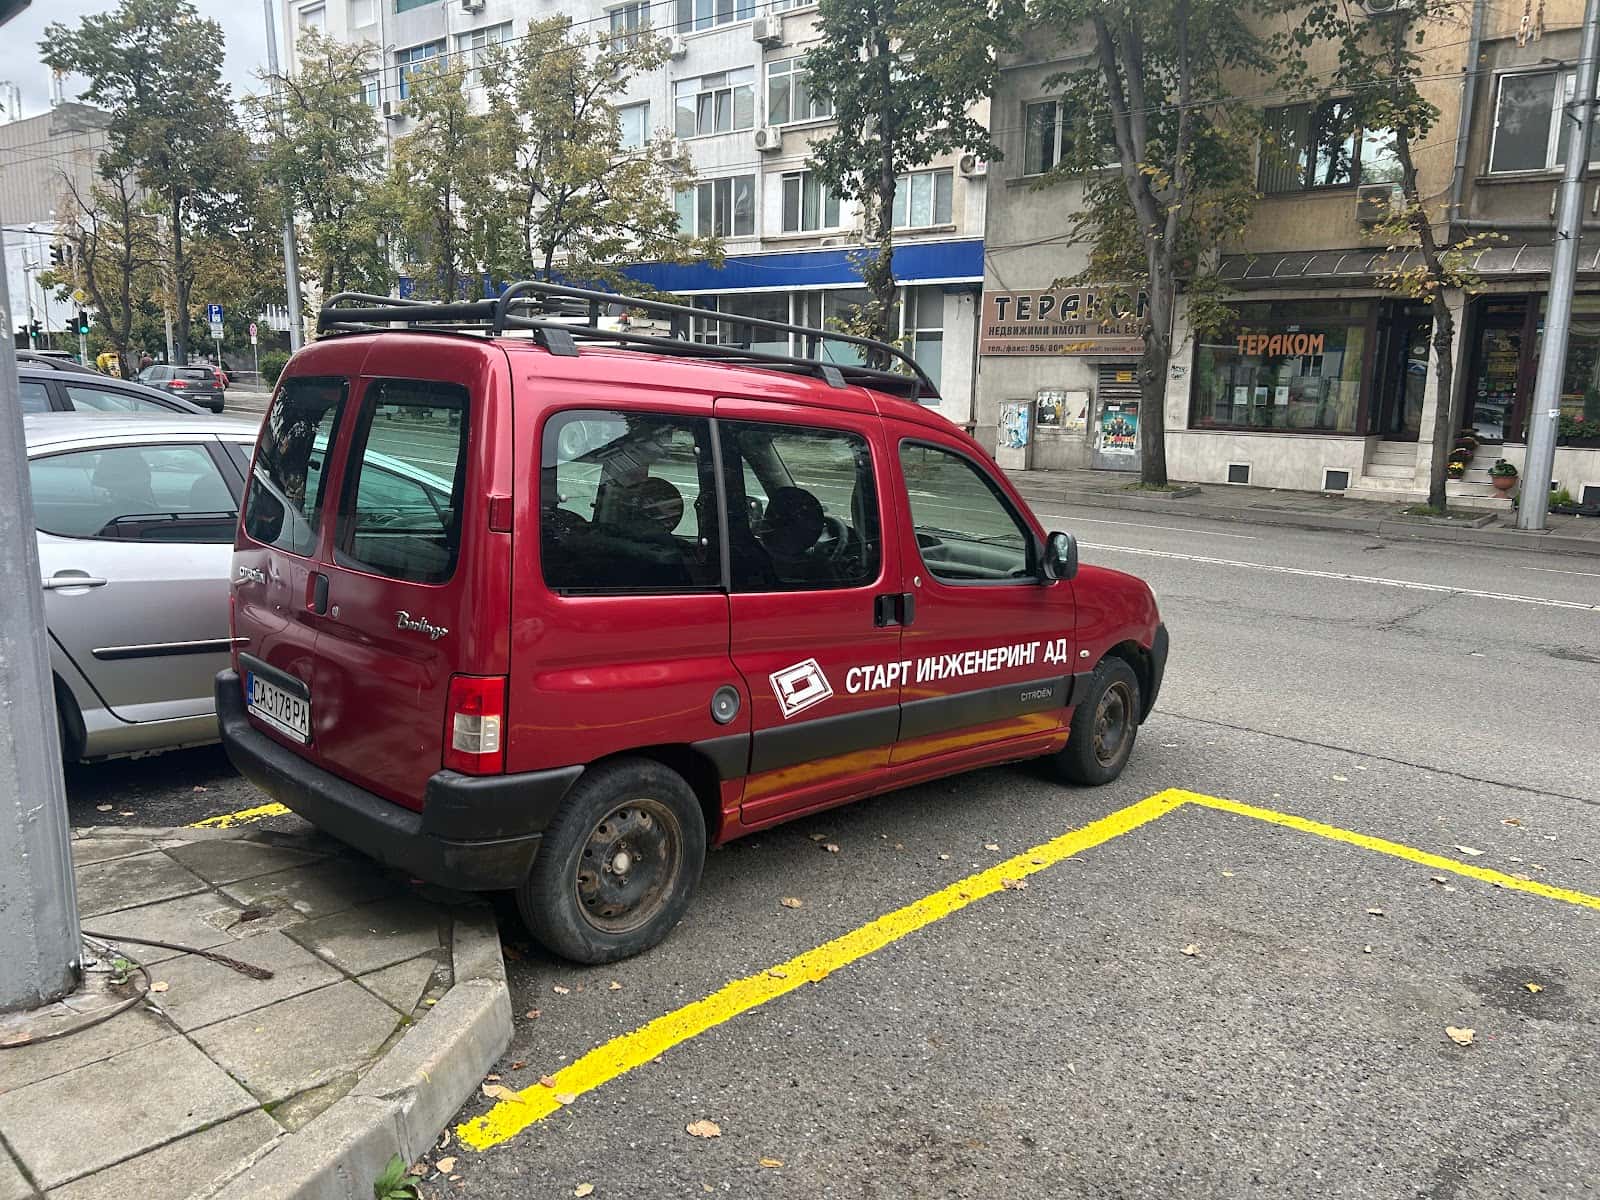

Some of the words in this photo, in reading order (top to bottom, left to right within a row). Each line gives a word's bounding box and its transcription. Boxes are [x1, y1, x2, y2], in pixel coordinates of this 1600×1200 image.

[988, 325, 1049, 337] НЕДВИЖИМИ
[1052, 324, 1087, 335] ИМОТИ
[1237, 333, 1325, 358] ТЕРАКОМ
[395, 610, 449, 640] Berlingo
[845, 660, 912, 694] СТАРТ
[916, 641, 1040, 683] ИНЖЕНЕРИНГ
[1043, 638, 1067, 665] АД
[1020, 687, 1054, 702] CITROËN
